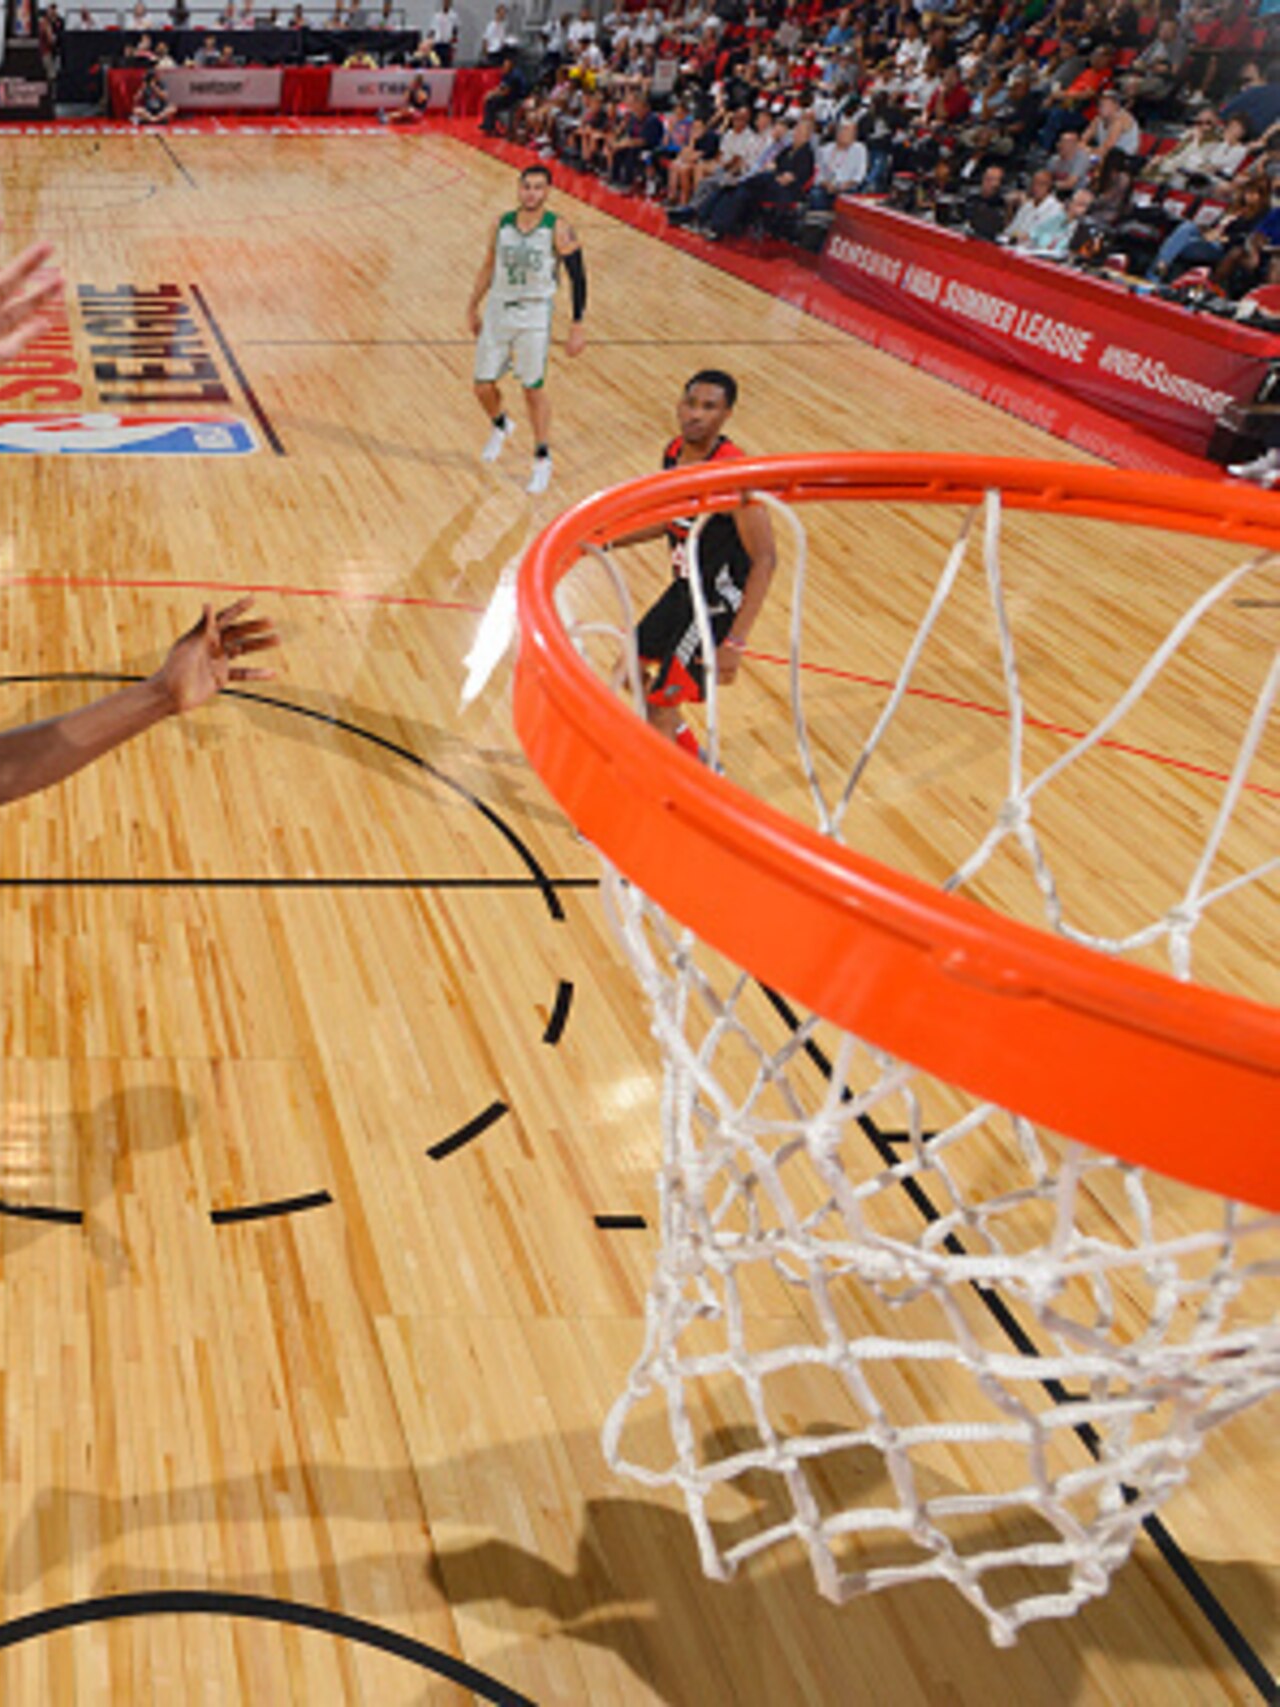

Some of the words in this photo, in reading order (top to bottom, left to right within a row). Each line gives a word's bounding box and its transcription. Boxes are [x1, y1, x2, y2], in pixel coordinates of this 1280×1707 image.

[76, 284, 231, 404] LEAGUE
[939, 280, 1018, 333] SUMMER
[1013, 310, 1094, 363] LEAGUE
